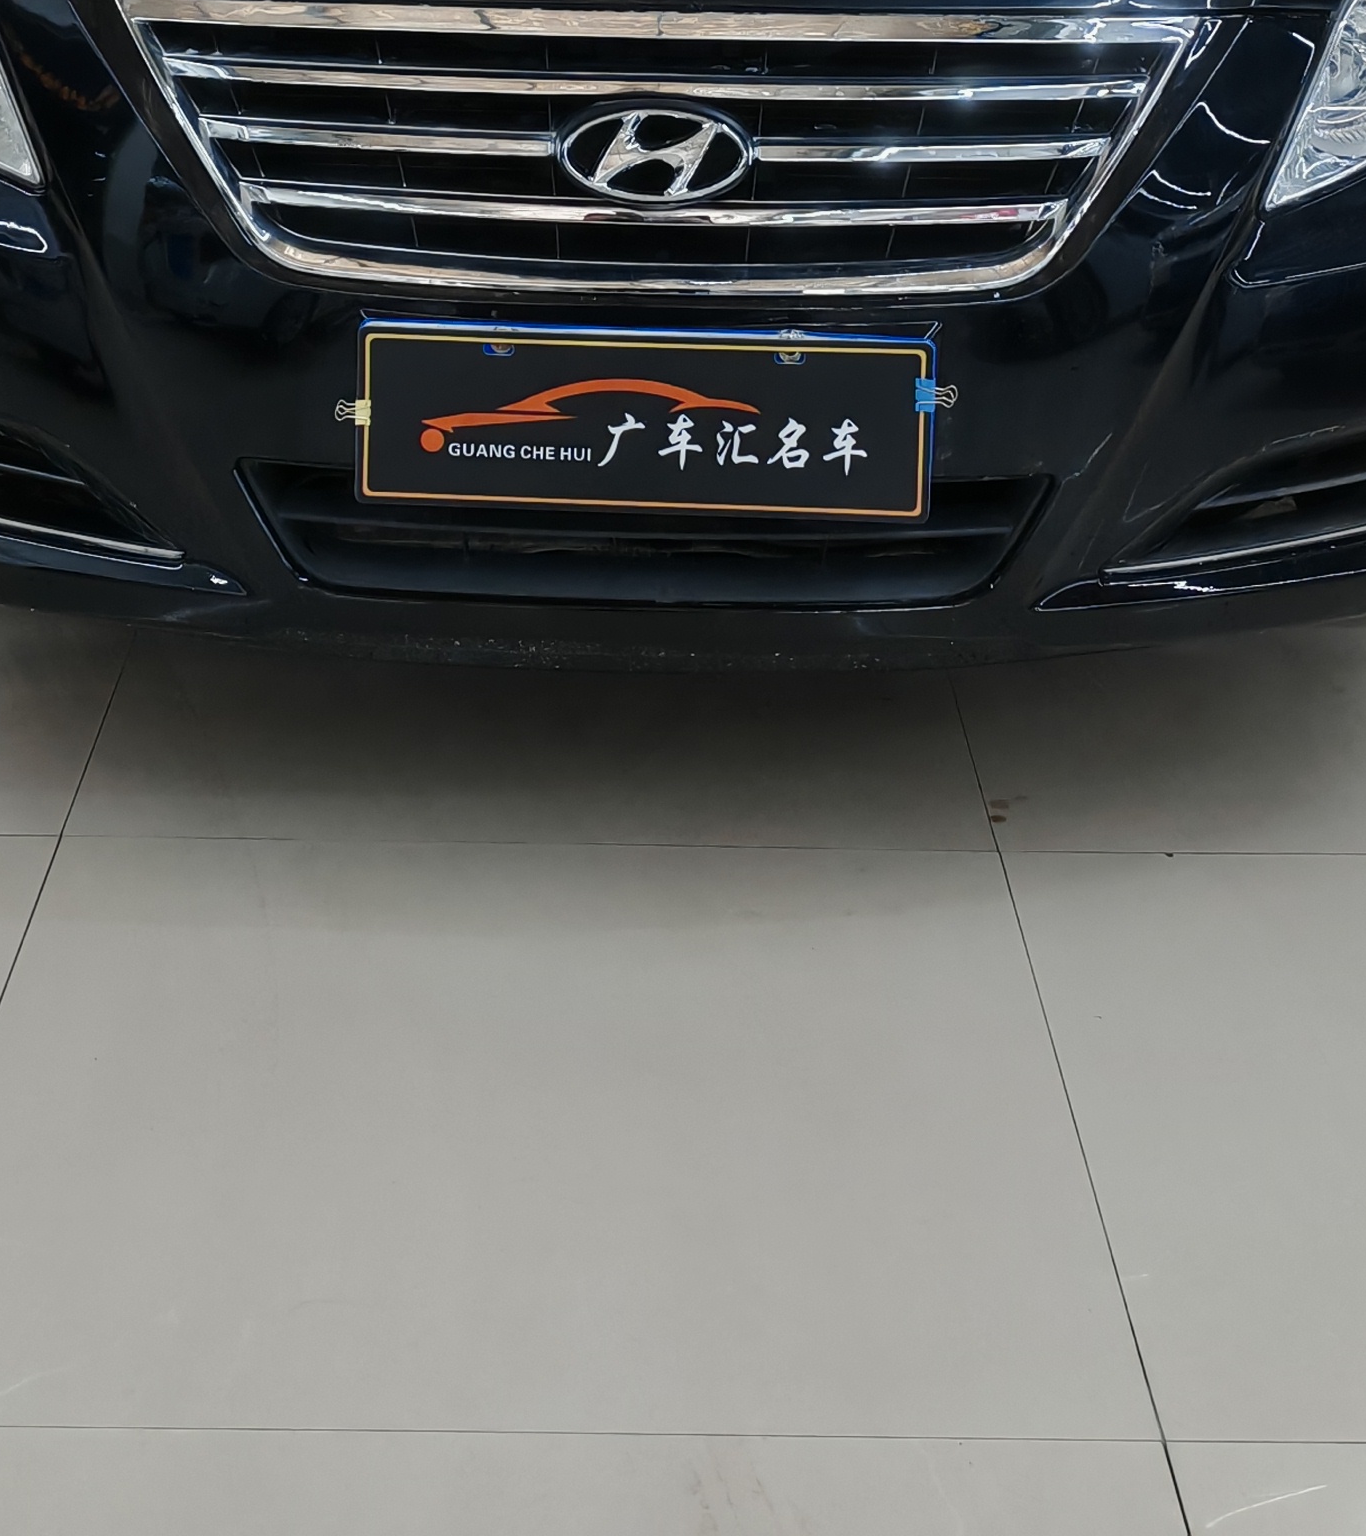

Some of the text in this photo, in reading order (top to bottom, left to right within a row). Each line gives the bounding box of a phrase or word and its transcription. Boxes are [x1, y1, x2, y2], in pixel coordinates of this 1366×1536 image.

[448, 442, 592, 462] GUANG CHE HUI
[597, 413, 869, 475] 广车汇名车
